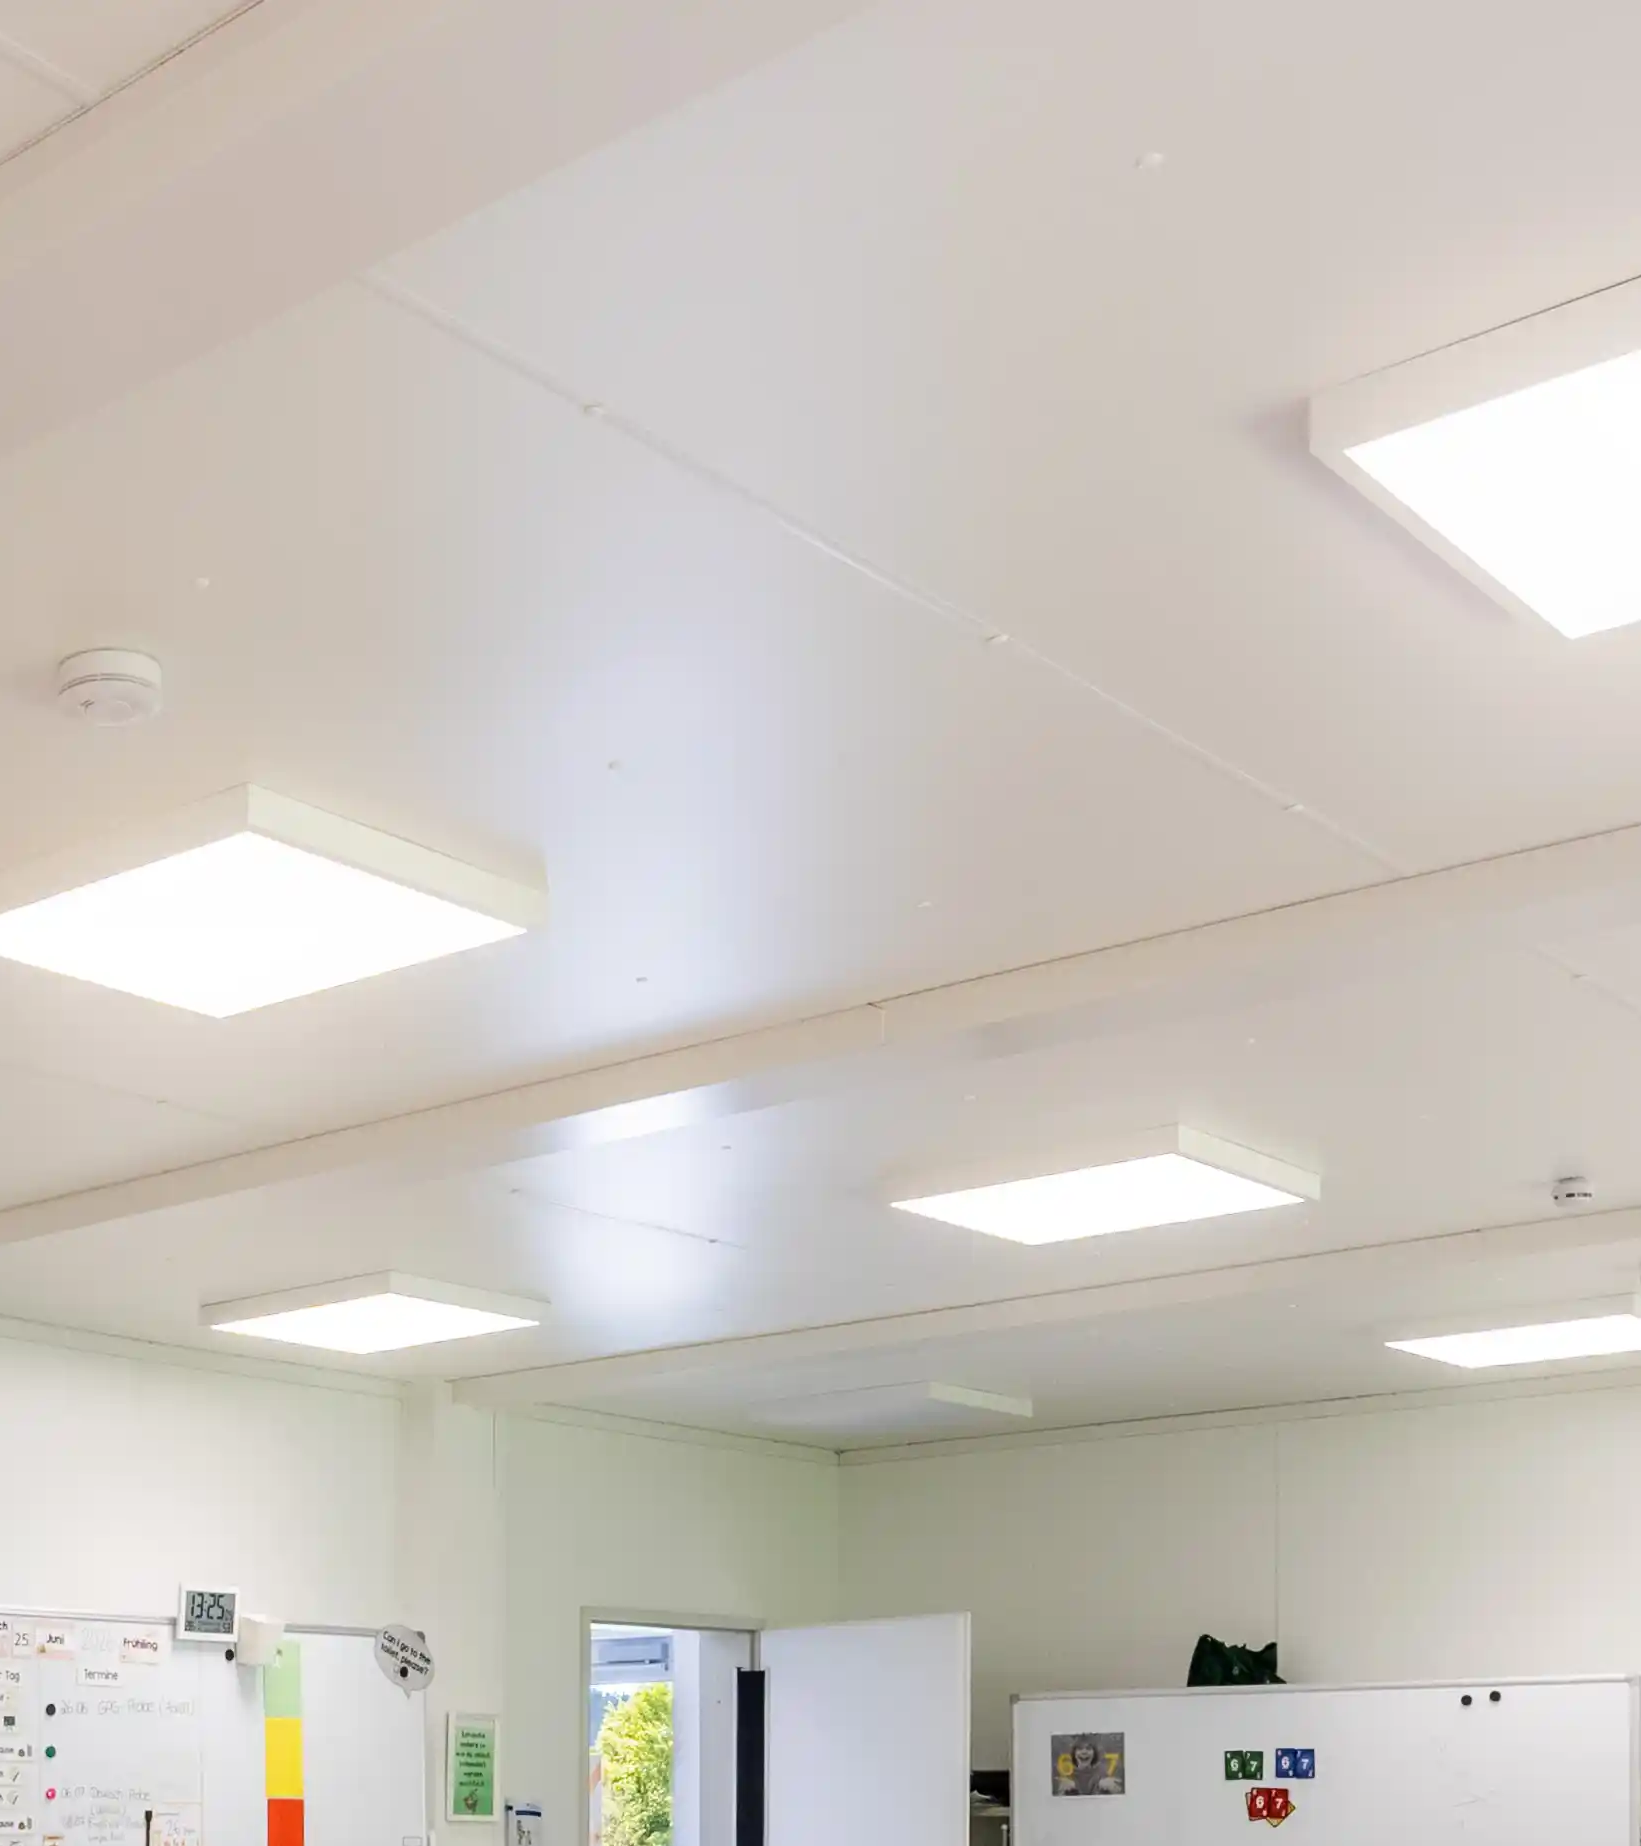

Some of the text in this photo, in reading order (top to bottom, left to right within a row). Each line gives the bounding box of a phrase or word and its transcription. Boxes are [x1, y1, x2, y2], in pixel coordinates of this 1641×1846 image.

[190, 1592, 225, 1620] 13:25
[15, 1633, 28, 1645] 25
[47, 1634, 64, 1644] Juni
[123, 1639, 157, 1652] Frühling
[383, 1631, 396, 1644] Can
[400, 1643, 409, 1652] go
[410, 1648, 417, 1657] to
[419, 1652, 430, 1665] the
[84, 1669, 117, 1680] Termine
[400, 1656, 429, 1675] please?
[6, 1671, 20, 1682] Tag
[1057, 1753, 1119, 1776] 6 7
